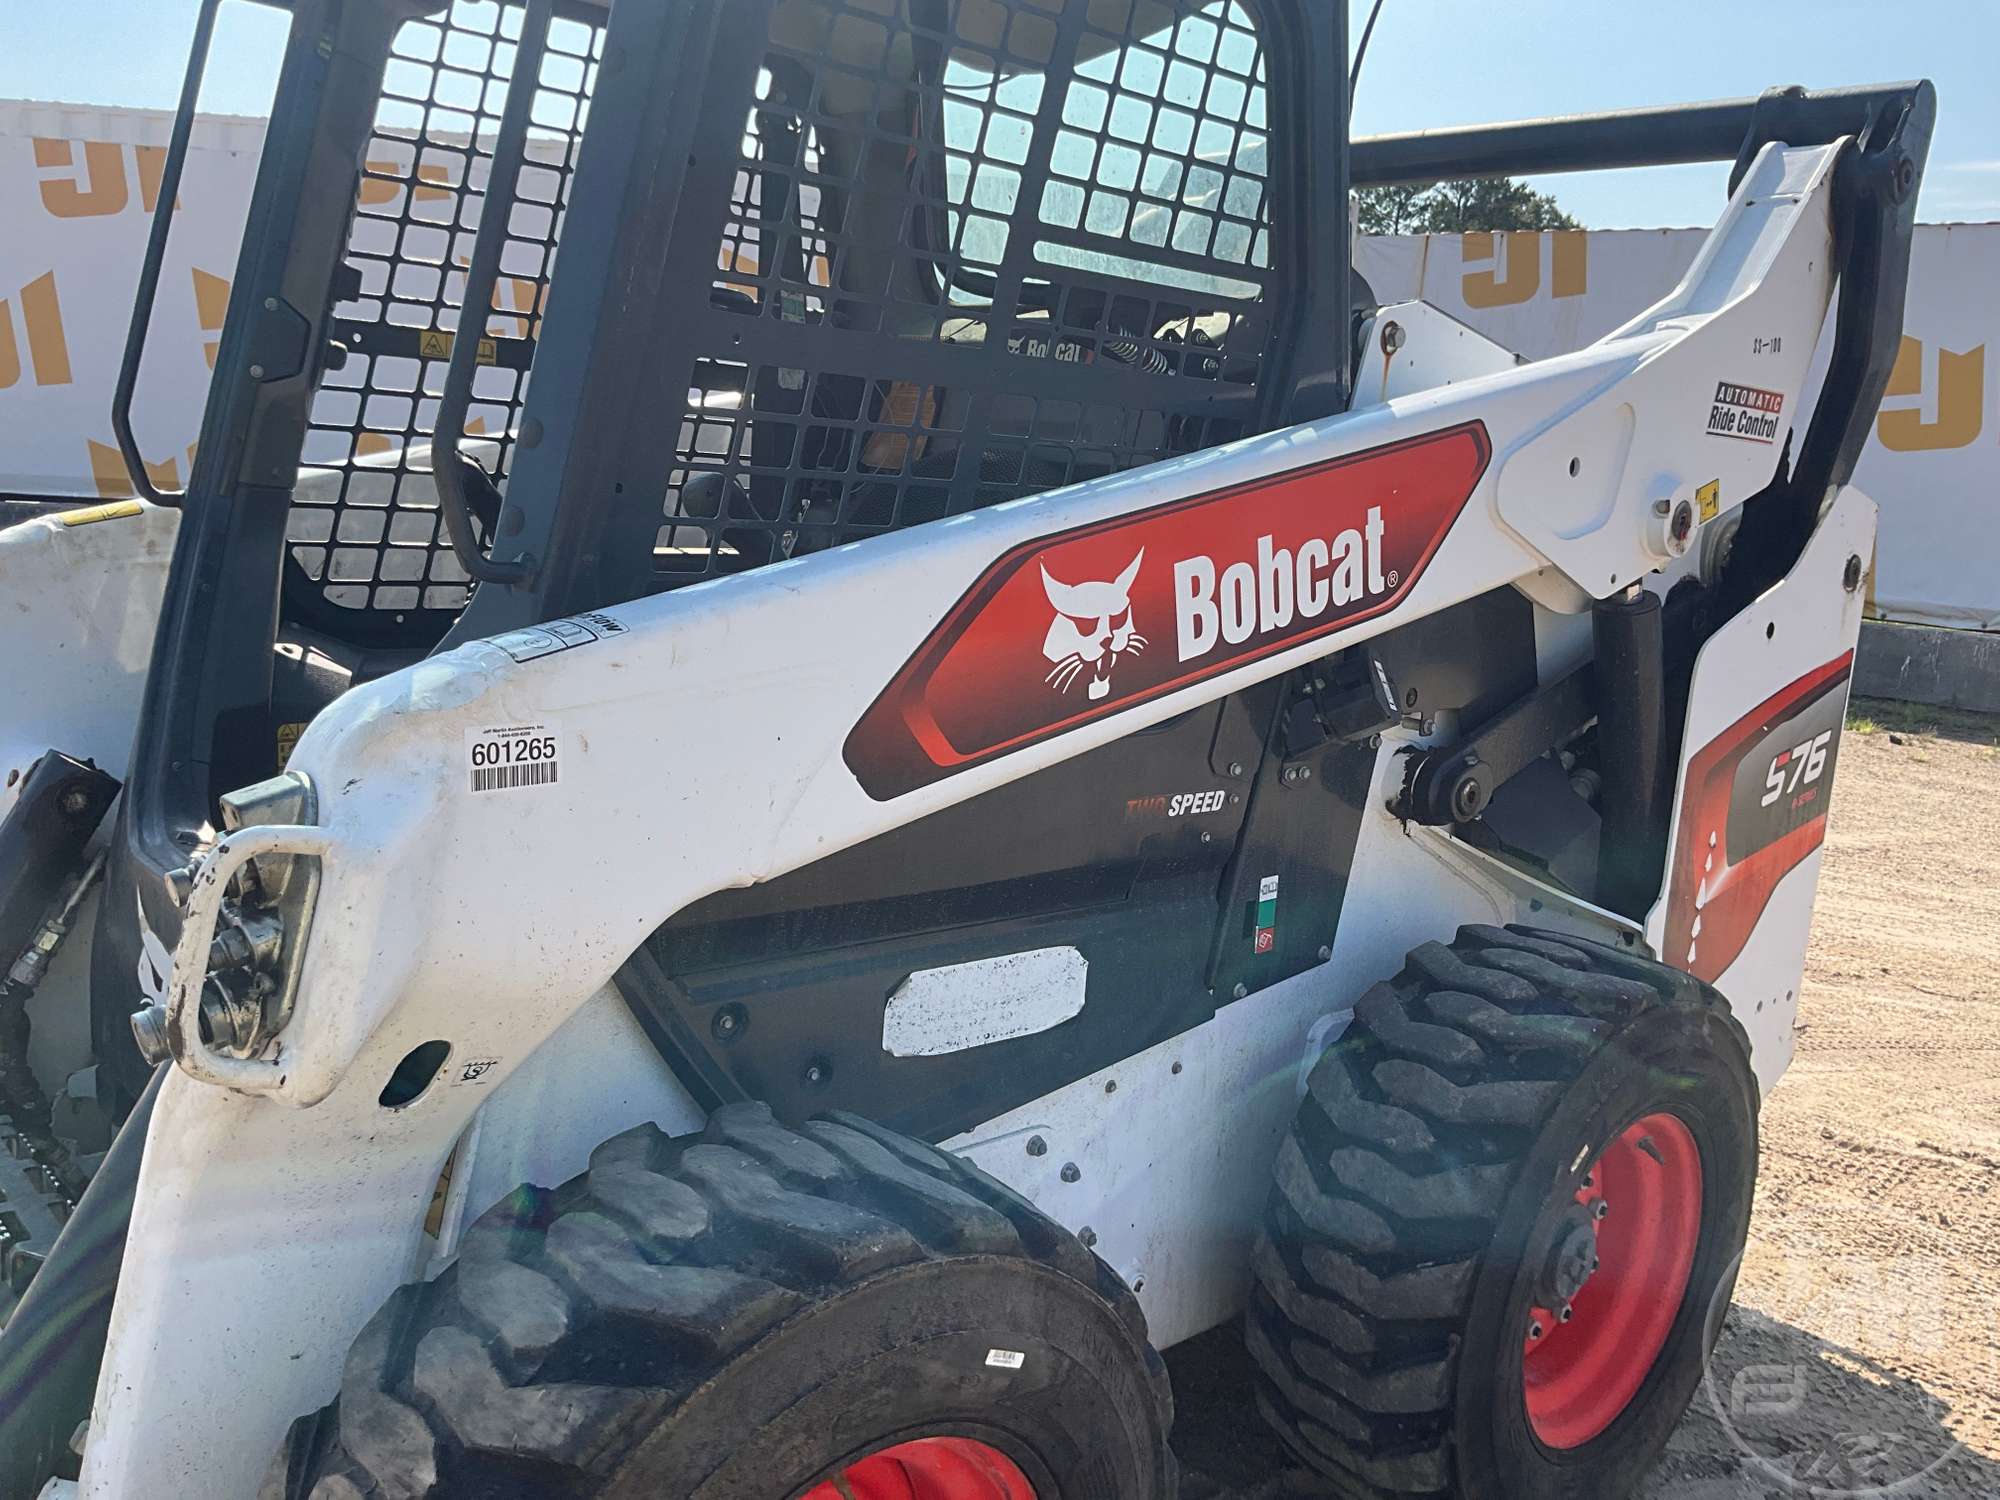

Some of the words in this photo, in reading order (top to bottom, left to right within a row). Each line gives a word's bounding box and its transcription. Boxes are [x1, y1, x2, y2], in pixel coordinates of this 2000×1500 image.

[1717, 386, 1781, 411] AUTOMATIC
[1708, 405, 1736, 432] Ride
[1737, 410, 1779, 439] Control
[1174, 505, 1385, 663] Bobcat
[472, 737, 555, 766] 601265
[1761, 730, 1832, 807] S76
[1168, 790, 1225, 817] SPEED
